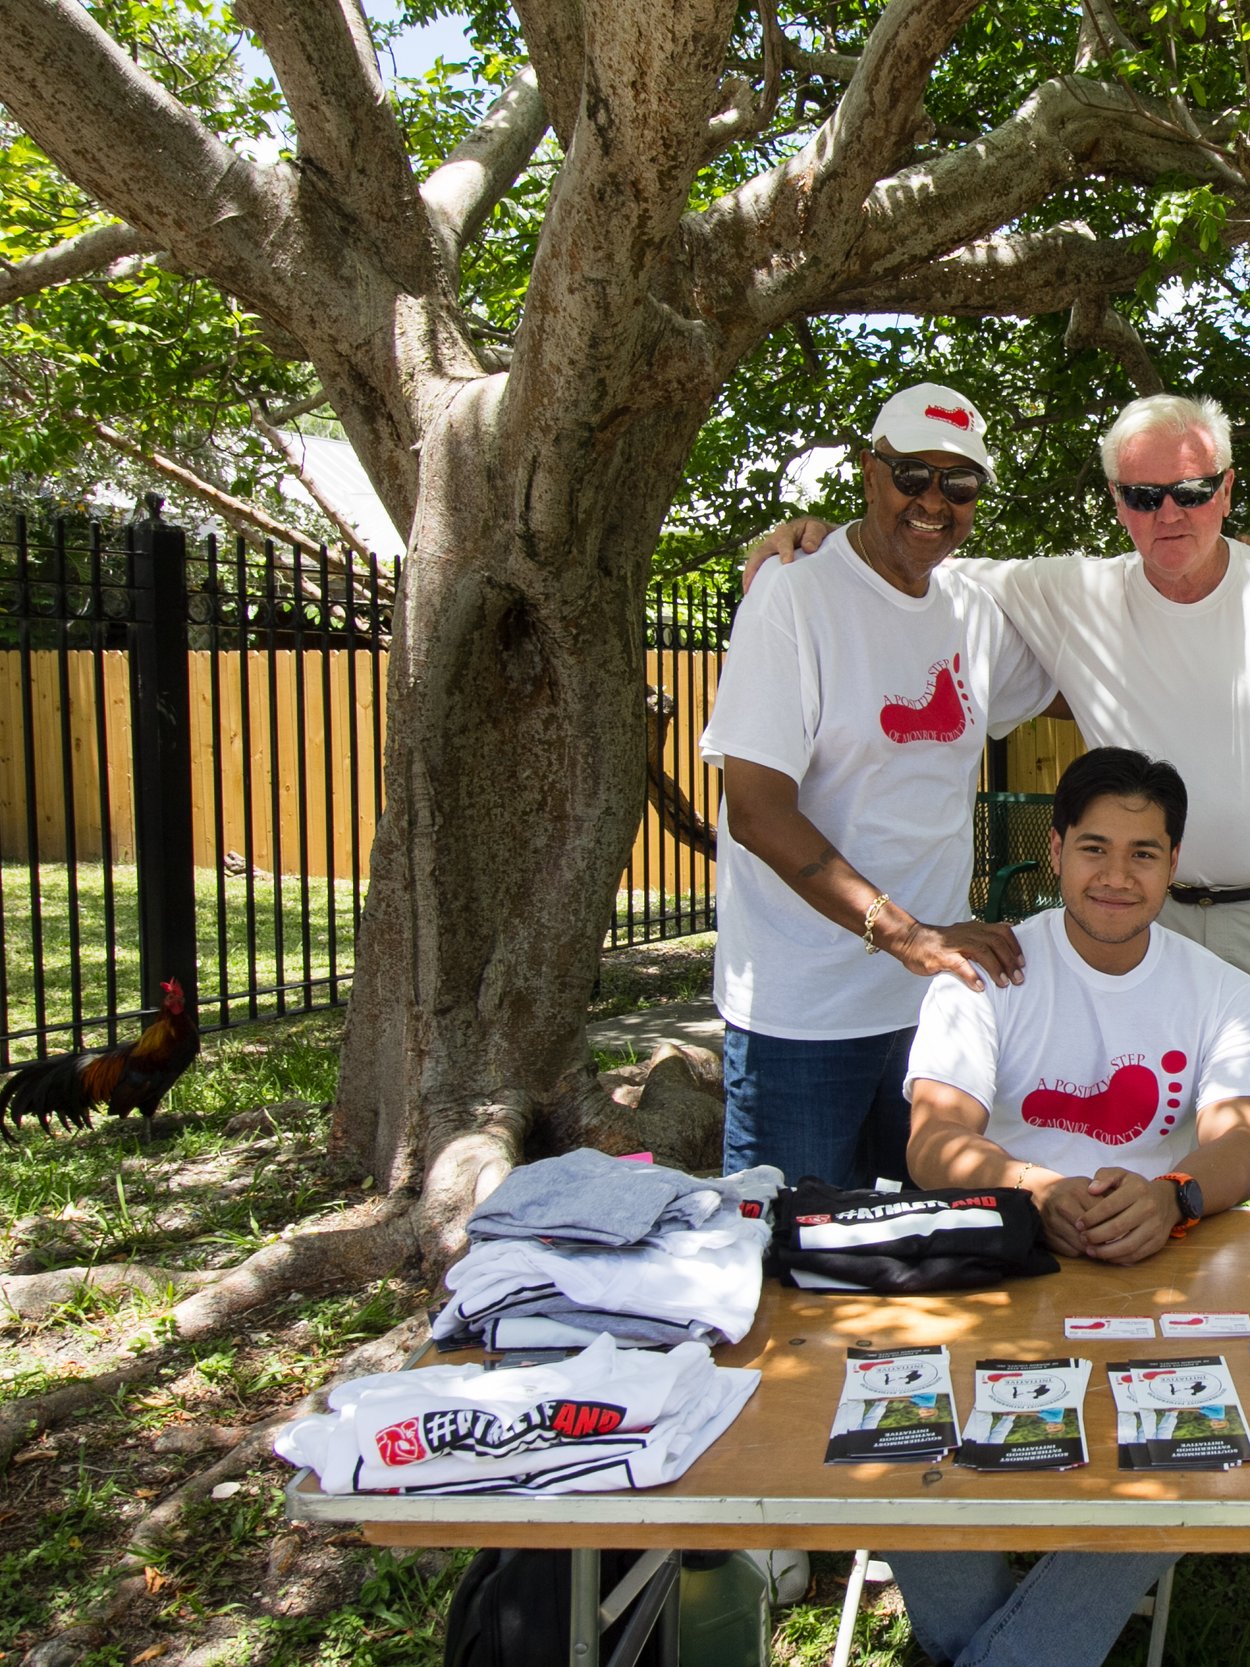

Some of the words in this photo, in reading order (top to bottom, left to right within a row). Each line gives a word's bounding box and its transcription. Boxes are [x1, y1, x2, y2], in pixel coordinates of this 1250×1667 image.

[1037, 1077, 1047, 1090] A
[1110, 1053, 1146, 1072] STEP
[1027, 1115, 1044, 1127] OF
[1092, 1122, 1144, 1146] COUNTY
